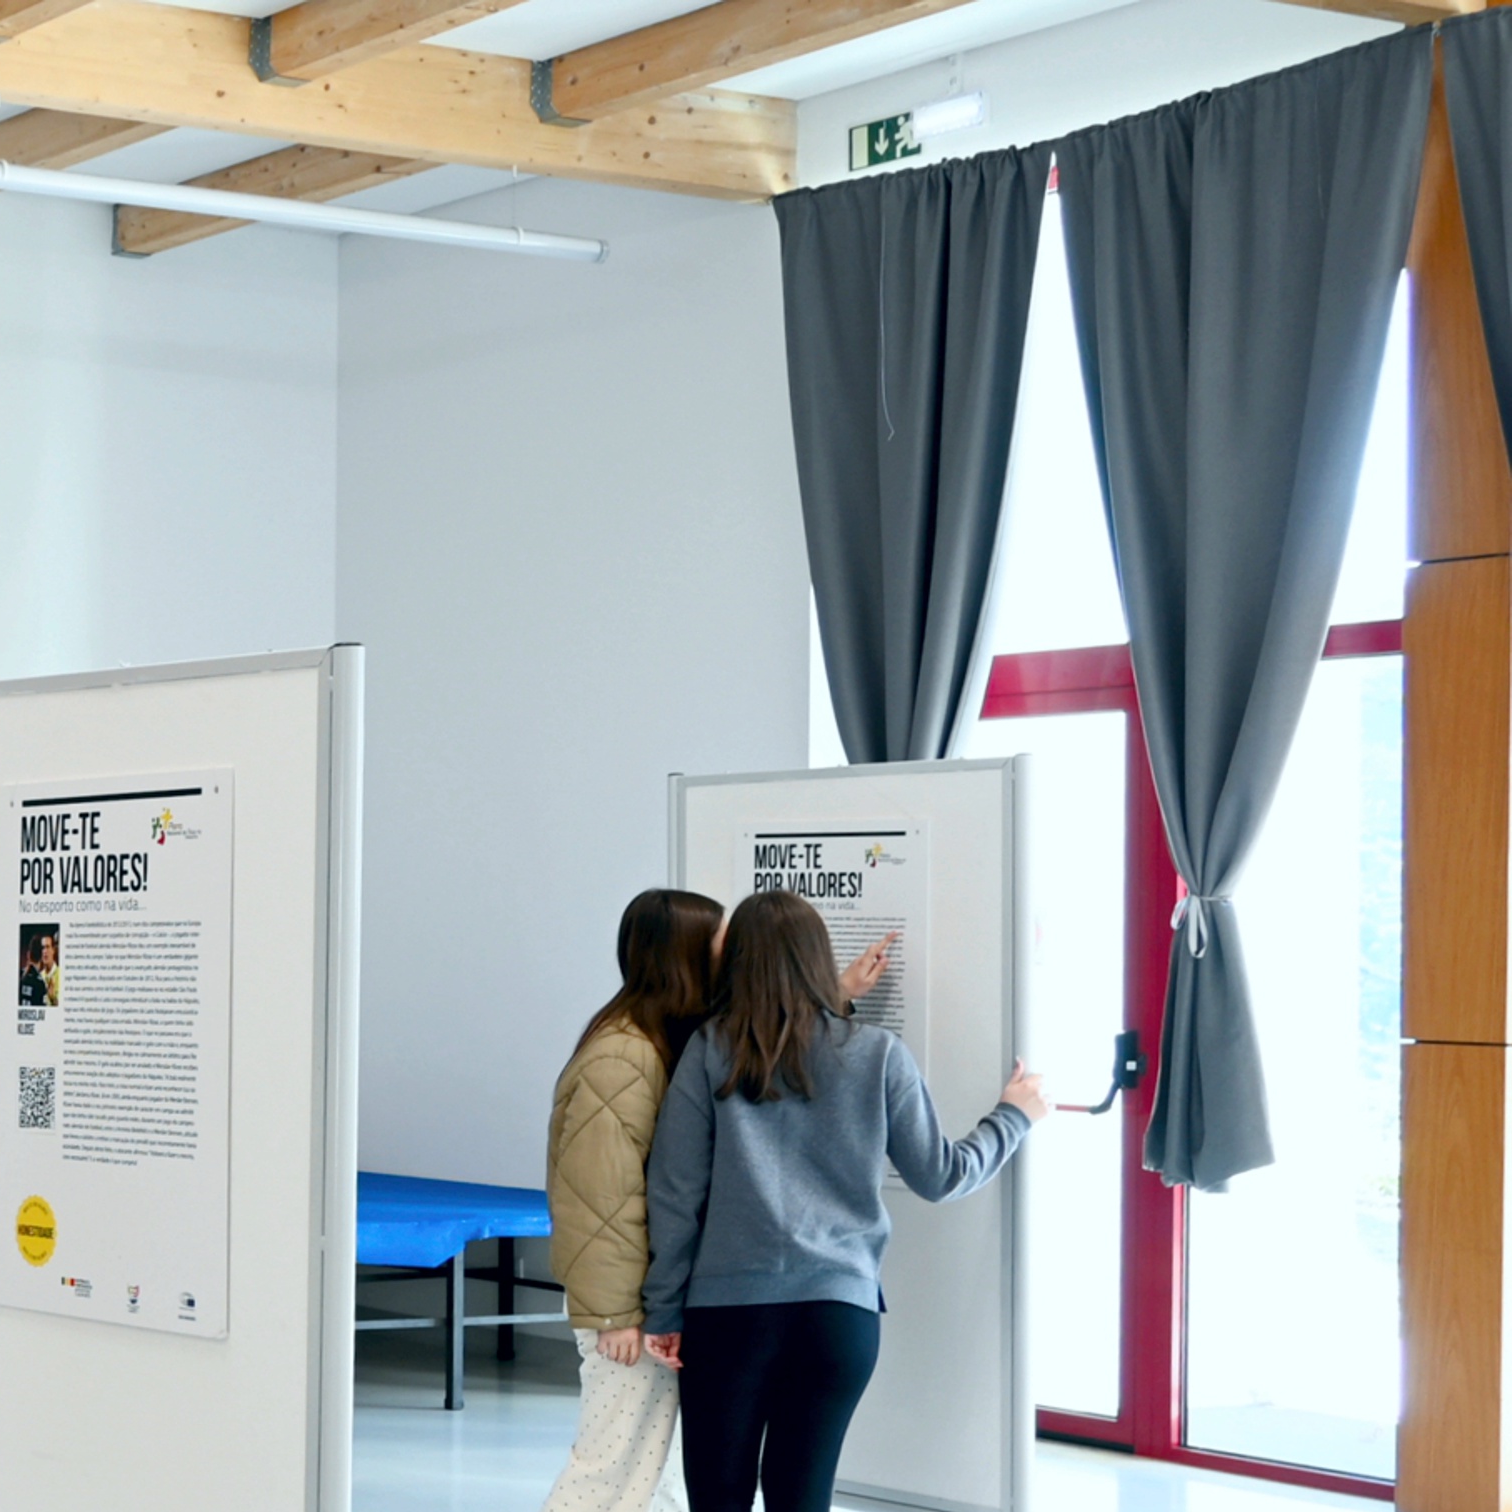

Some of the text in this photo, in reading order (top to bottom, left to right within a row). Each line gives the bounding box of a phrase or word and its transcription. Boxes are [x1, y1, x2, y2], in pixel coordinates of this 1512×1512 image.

[21, 811, 100, 853] MOVE-TE
[754, 843, 823, 869] MOVE-TE
[20, 853, 148, 895] POR VALORES!
[787, 871, 863, 898] VALORES!
[19, 899, 32, 913] No
[34, 898, 74, 916] desporto
[76, 898, 102, 912] como
[104, 899, 116, 911] na
